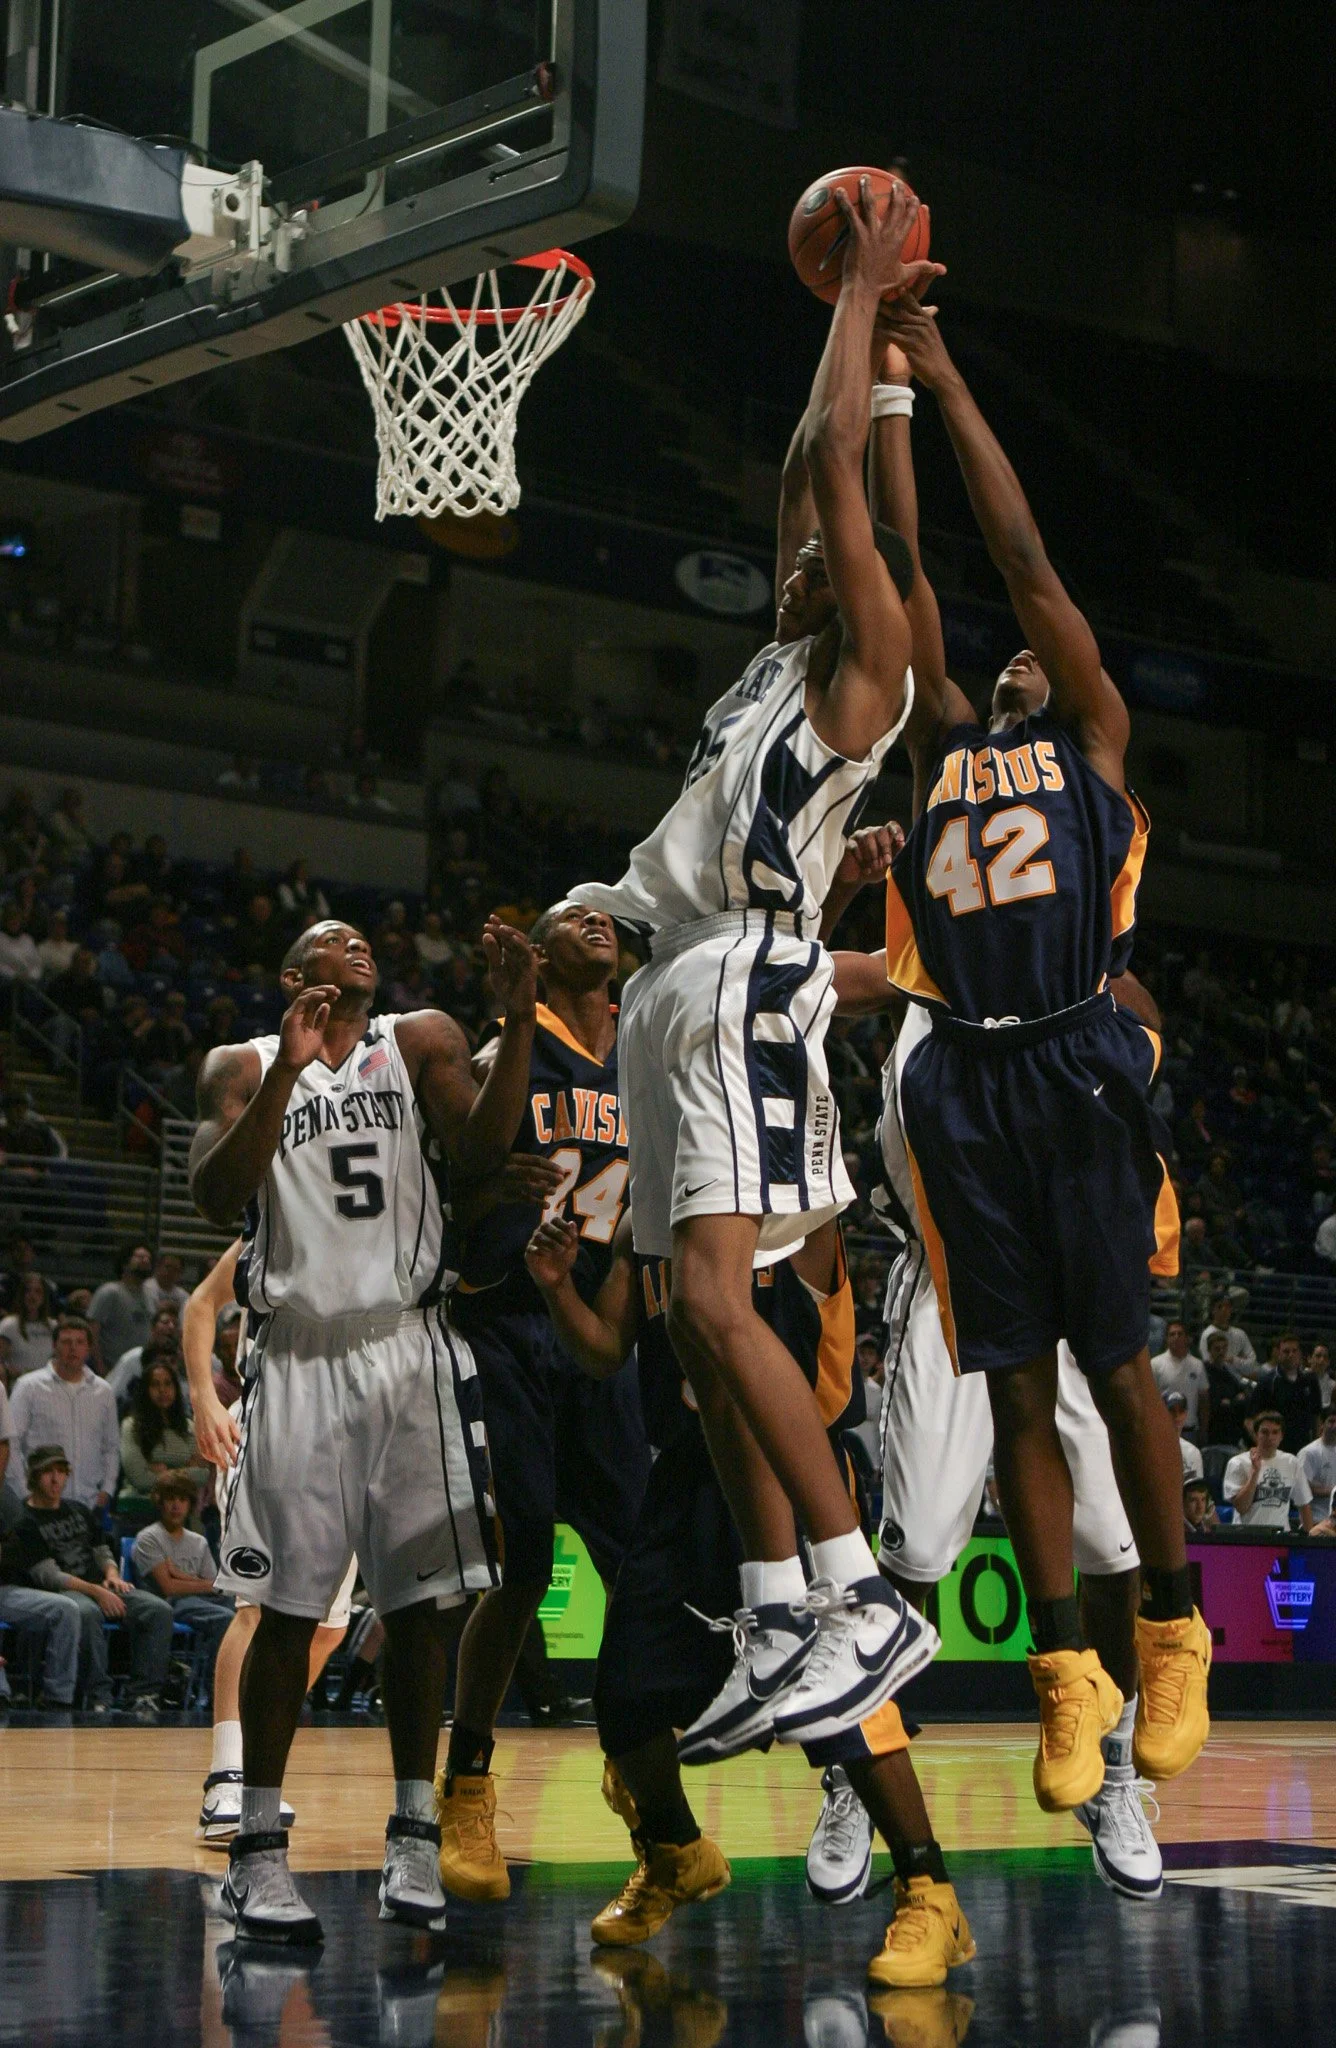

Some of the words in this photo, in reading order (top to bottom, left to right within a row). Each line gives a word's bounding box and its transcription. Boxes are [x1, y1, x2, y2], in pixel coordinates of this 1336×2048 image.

[926, 804, 1056, 917] 42
[280, 1094, 340, 1160] PENN
[814, 1095, 829, 1136] STATE
[328, 1141, 386, 1221] 5
[812, 1141, 825, 1175] PENN
[541, 1147, 628, 1244] 24
[1275, 1591, 1312, 1602] LOTTERY
